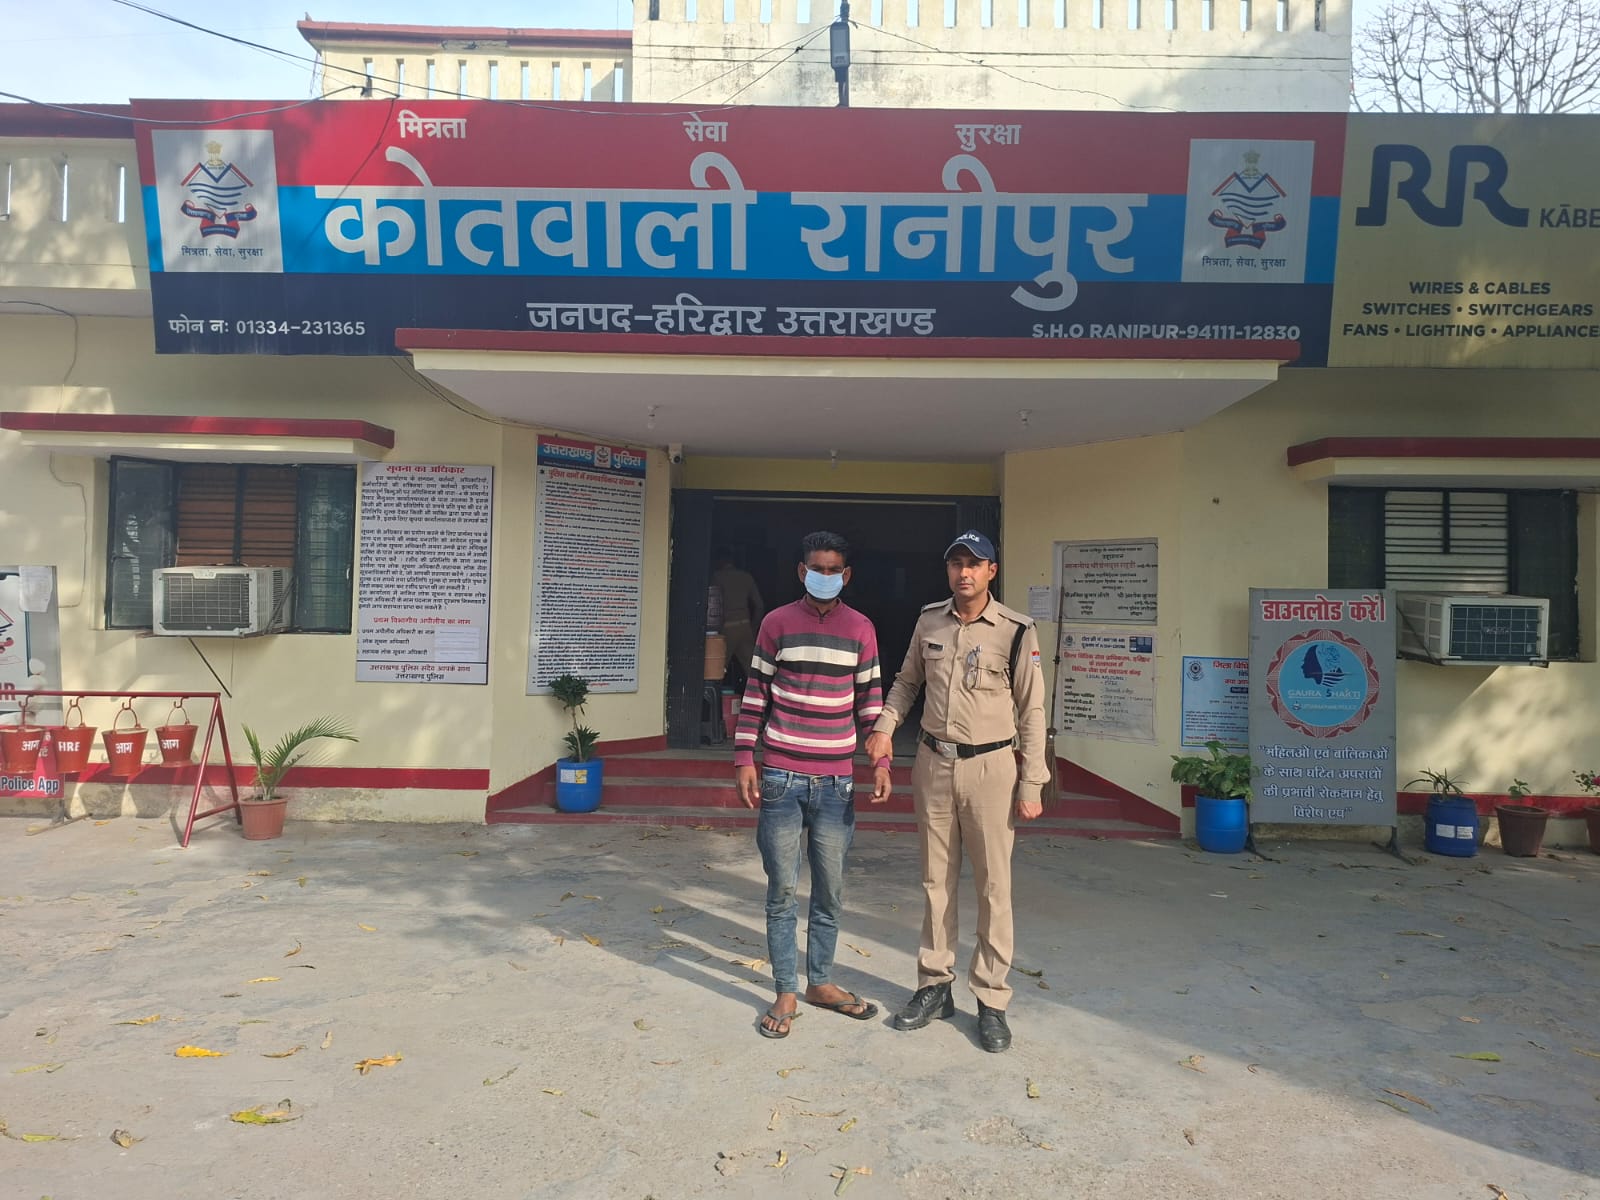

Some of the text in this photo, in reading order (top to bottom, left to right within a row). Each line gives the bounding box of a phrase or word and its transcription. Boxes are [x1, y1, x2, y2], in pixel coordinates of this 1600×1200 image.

[398, 109, 467, 139] मित्रता
[683, 113, 728, 143] सेवा
[954, 123, 1021, 152] सुरक्षा
[1355, 144, 1529, 227] RR
[315, 146, 1148, 311] कोतवाली रानीपुर
[238, 247, 263, 259] सुरक्षा
[1260, 257, 1286, 271] सुरक्षा
[1409, 281, 1551, 295] WIRES & CABLES
[526, 293, 937, 336] जनपद-हरिद्वार उत्तराखण्ड
[1362, 302, 1593, 316] SWITCHES SWITCHGEARS
[168, 314, 204, 335] फोन
[236, 320, 366, 336] 01334-231365
[1032, 323, 1301, 341] S.H.O RANIPUR-94111-12830
[1343, 324, 1389, 337] FANS
[1406, 324, 1486, 337] LIGHTING
[543, 443, 641, 469] उत्तराखण्ड पुलिस
[414, 465, 426, 473] का
[430, 465, 465, 474] अधिकार
[1260, 594, 1345, 622] डाउनलोड
[21, 739, 41, 751] आग
[115, 742, 134, 755] आग
[160, 739, 180, 750] आग
[1314, 746, 1330, 760] एवं
[1333, 745, 1389, 761] बालिकाओं
[1263, 763, 1383, 780] के साथ घटित अपराधों
[1, 776, 60, 795] Police App
[1263, 783, 1384, 803] की प्रभावी रोकथाम हेतु
[1293, 805, 1324, 819] विशेष
